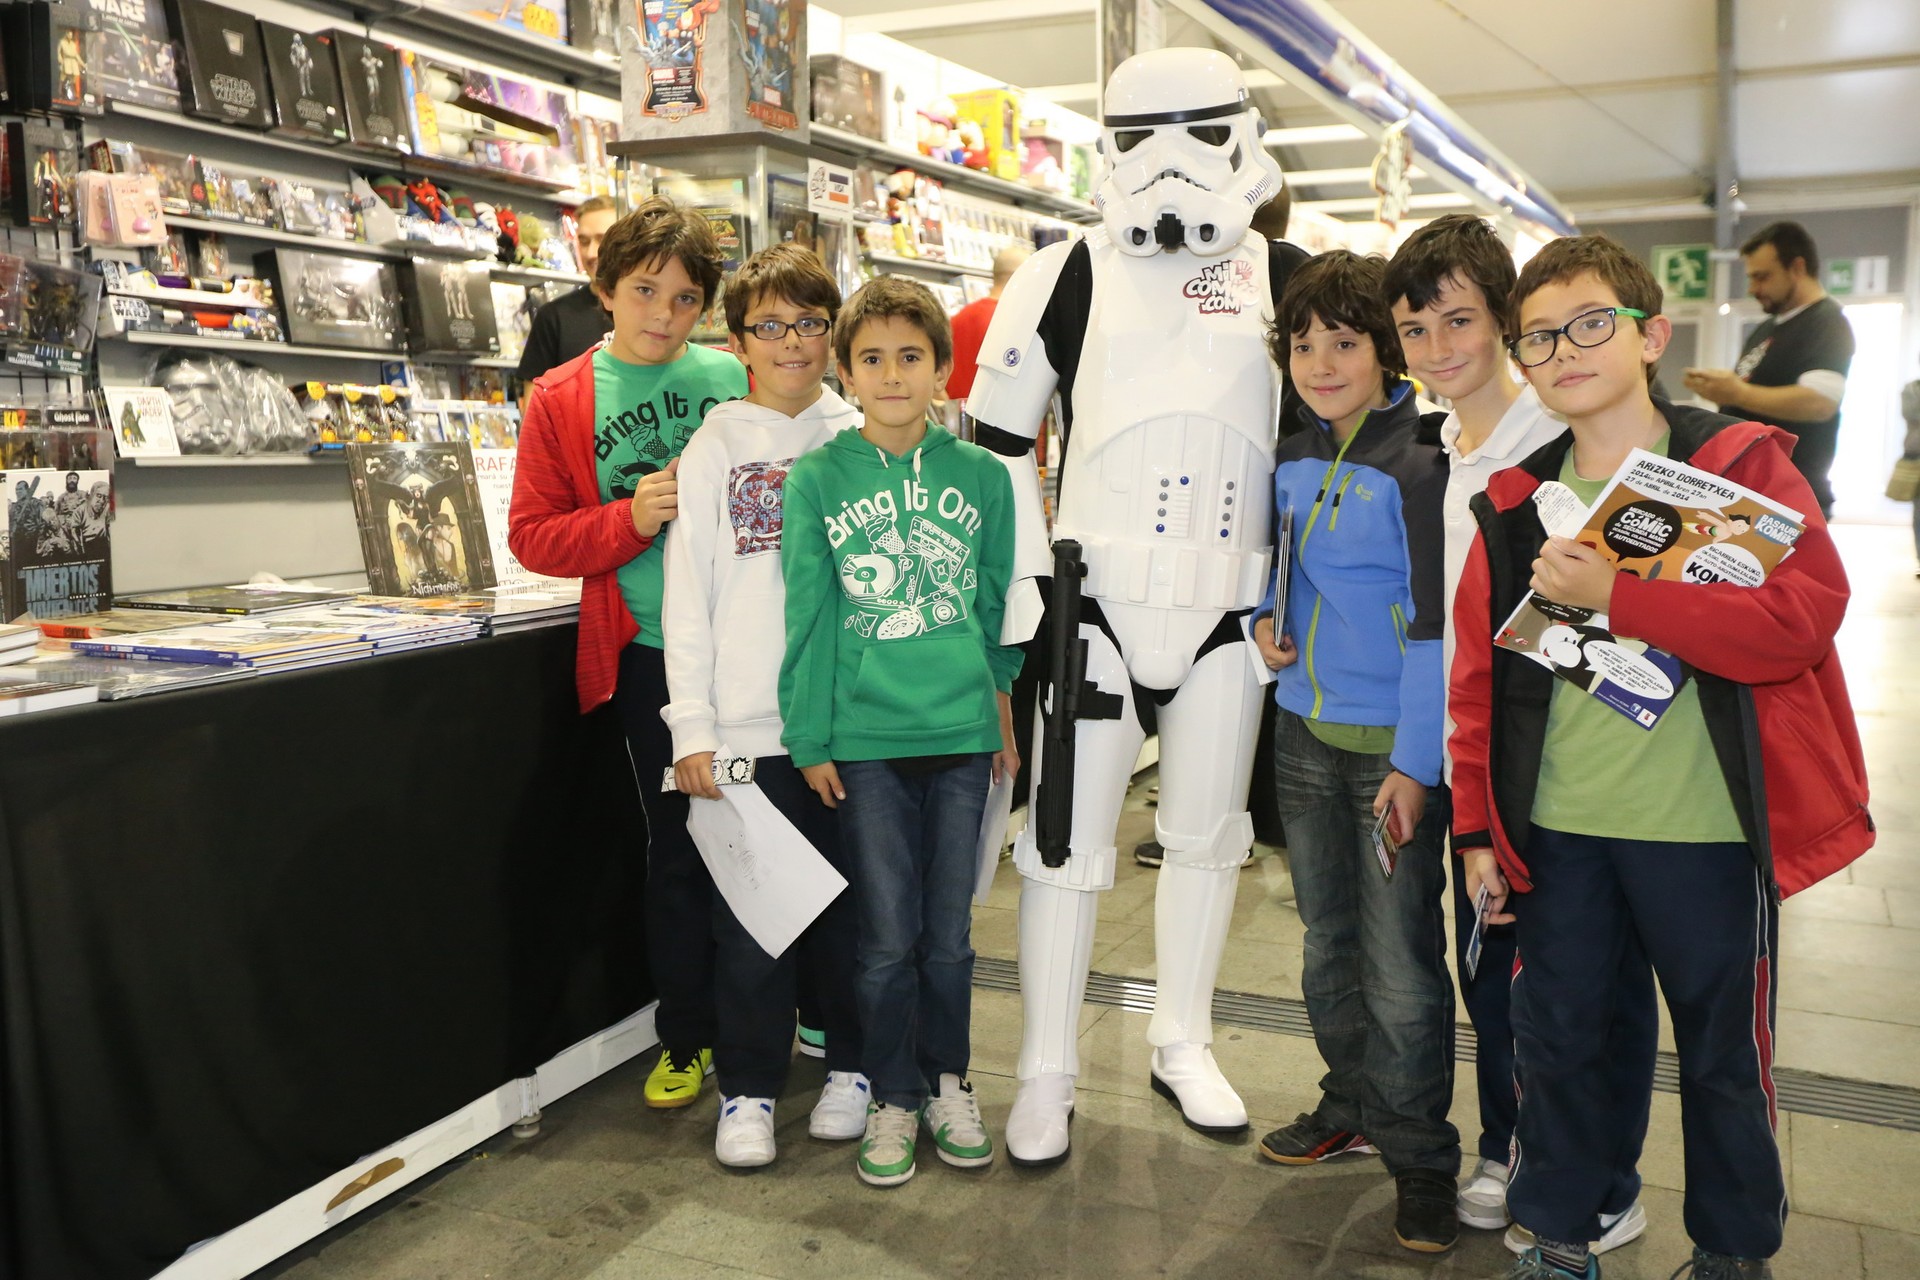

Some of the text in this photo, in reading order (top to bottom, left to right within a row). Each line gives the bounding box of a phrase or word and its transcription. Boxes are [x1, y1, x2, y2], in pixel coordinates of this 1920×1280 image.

[89, 0, 146, 23] WARS
[113, 299, 146, 309] STAR
[114, 307, 148, 317] WARS
[54, 411, 75, 423] Ghost
[594, 400, 660, 462] Bring
[663, 390, 689, 420] It
[1625, 475, 1635, 483] 27
[1671, 491, 1690, 502] 2014
[1676, 473, 1735, 500] DORRETXEA
[824, 479, 982, 549] Bring It On!
[1628, 506, 1656, 519] MERCADO
[1622, 525, 1648, 537] SEGUNDA
[1648, 534, 1667, 543] MANO
[1760, 514, 1800, 537] BASAURI
[1613, 533, 1659, 554] AUTOEDITADOS
[25, 563, 99, 602] MUERTOS
